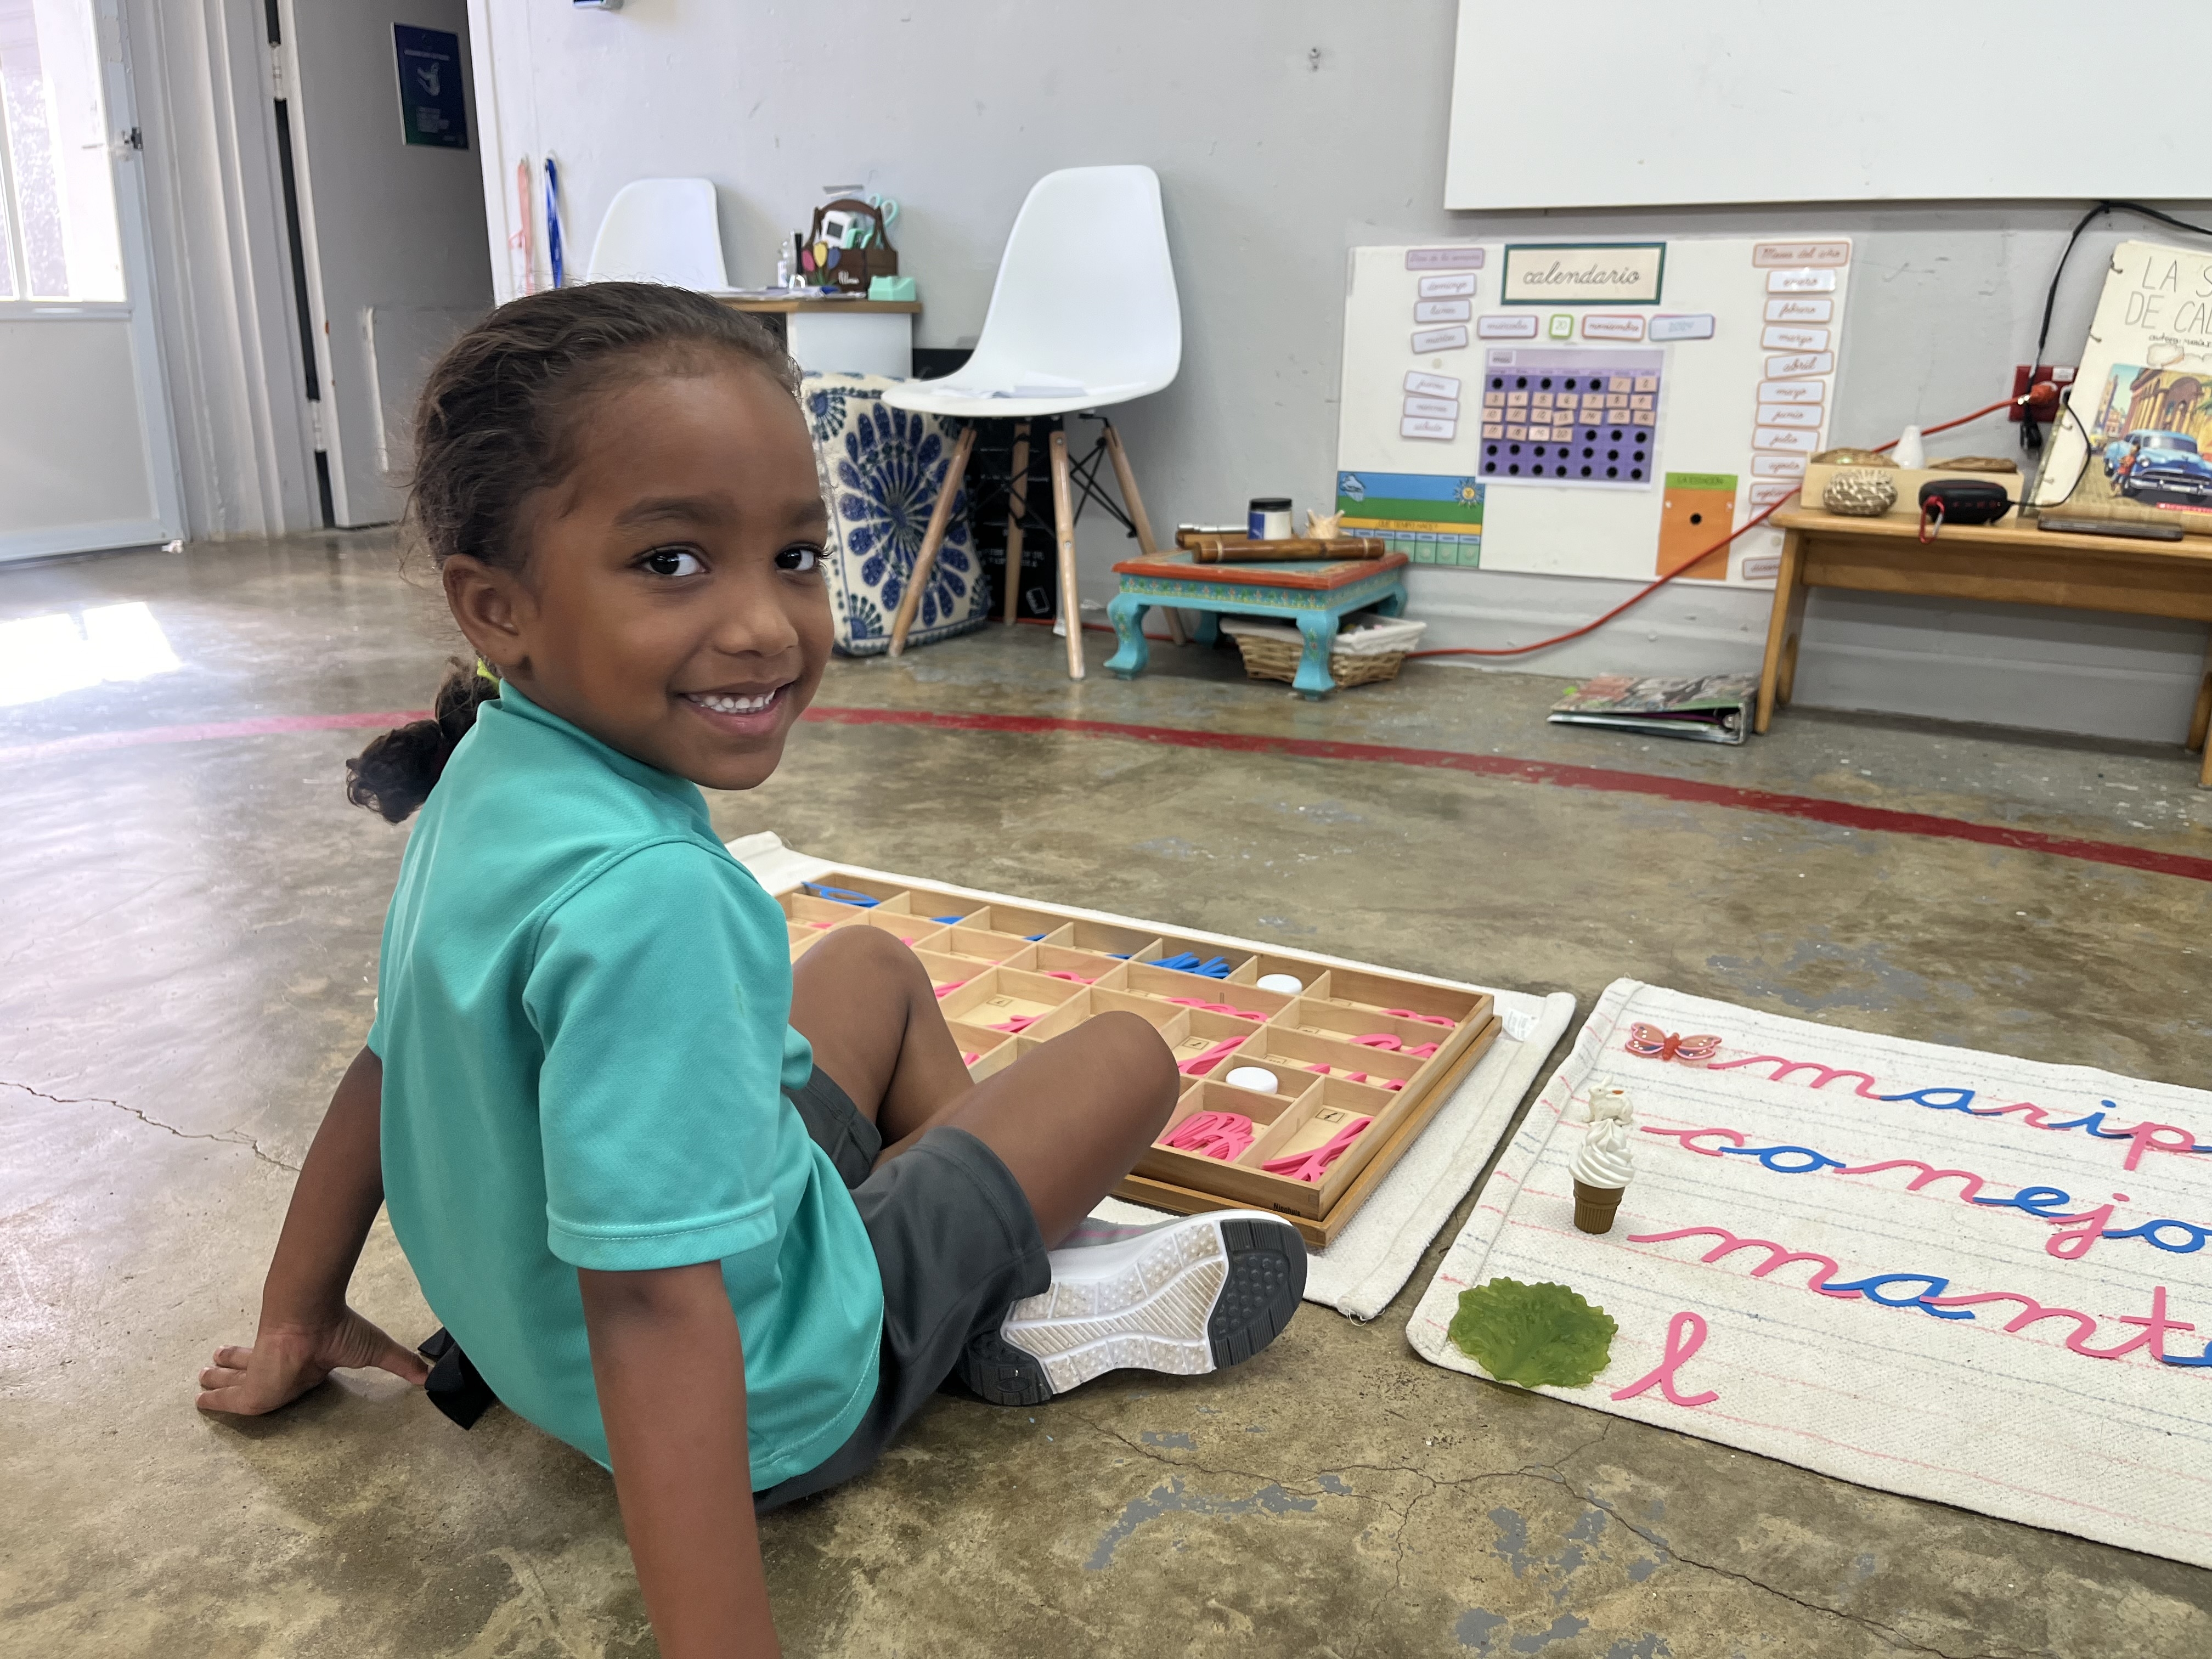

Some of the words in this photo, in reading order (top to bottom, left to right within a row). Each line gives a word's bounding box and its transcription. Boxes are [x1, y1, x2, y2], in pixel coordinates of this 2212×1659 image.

[1523, 261, 1640, 285] calendario
[2142, 256, 2177, 293] LA
[2125, 291, 2164, 329] DE
[1783, 356, 1818, 372] abril
[1707, 1054, 2212, 1171] marip
[1640, 1126, 2212, 1260] conejo
[1627, 1226, 2212, 1367] mant
[1610, 1311, 1719, 1406] l
